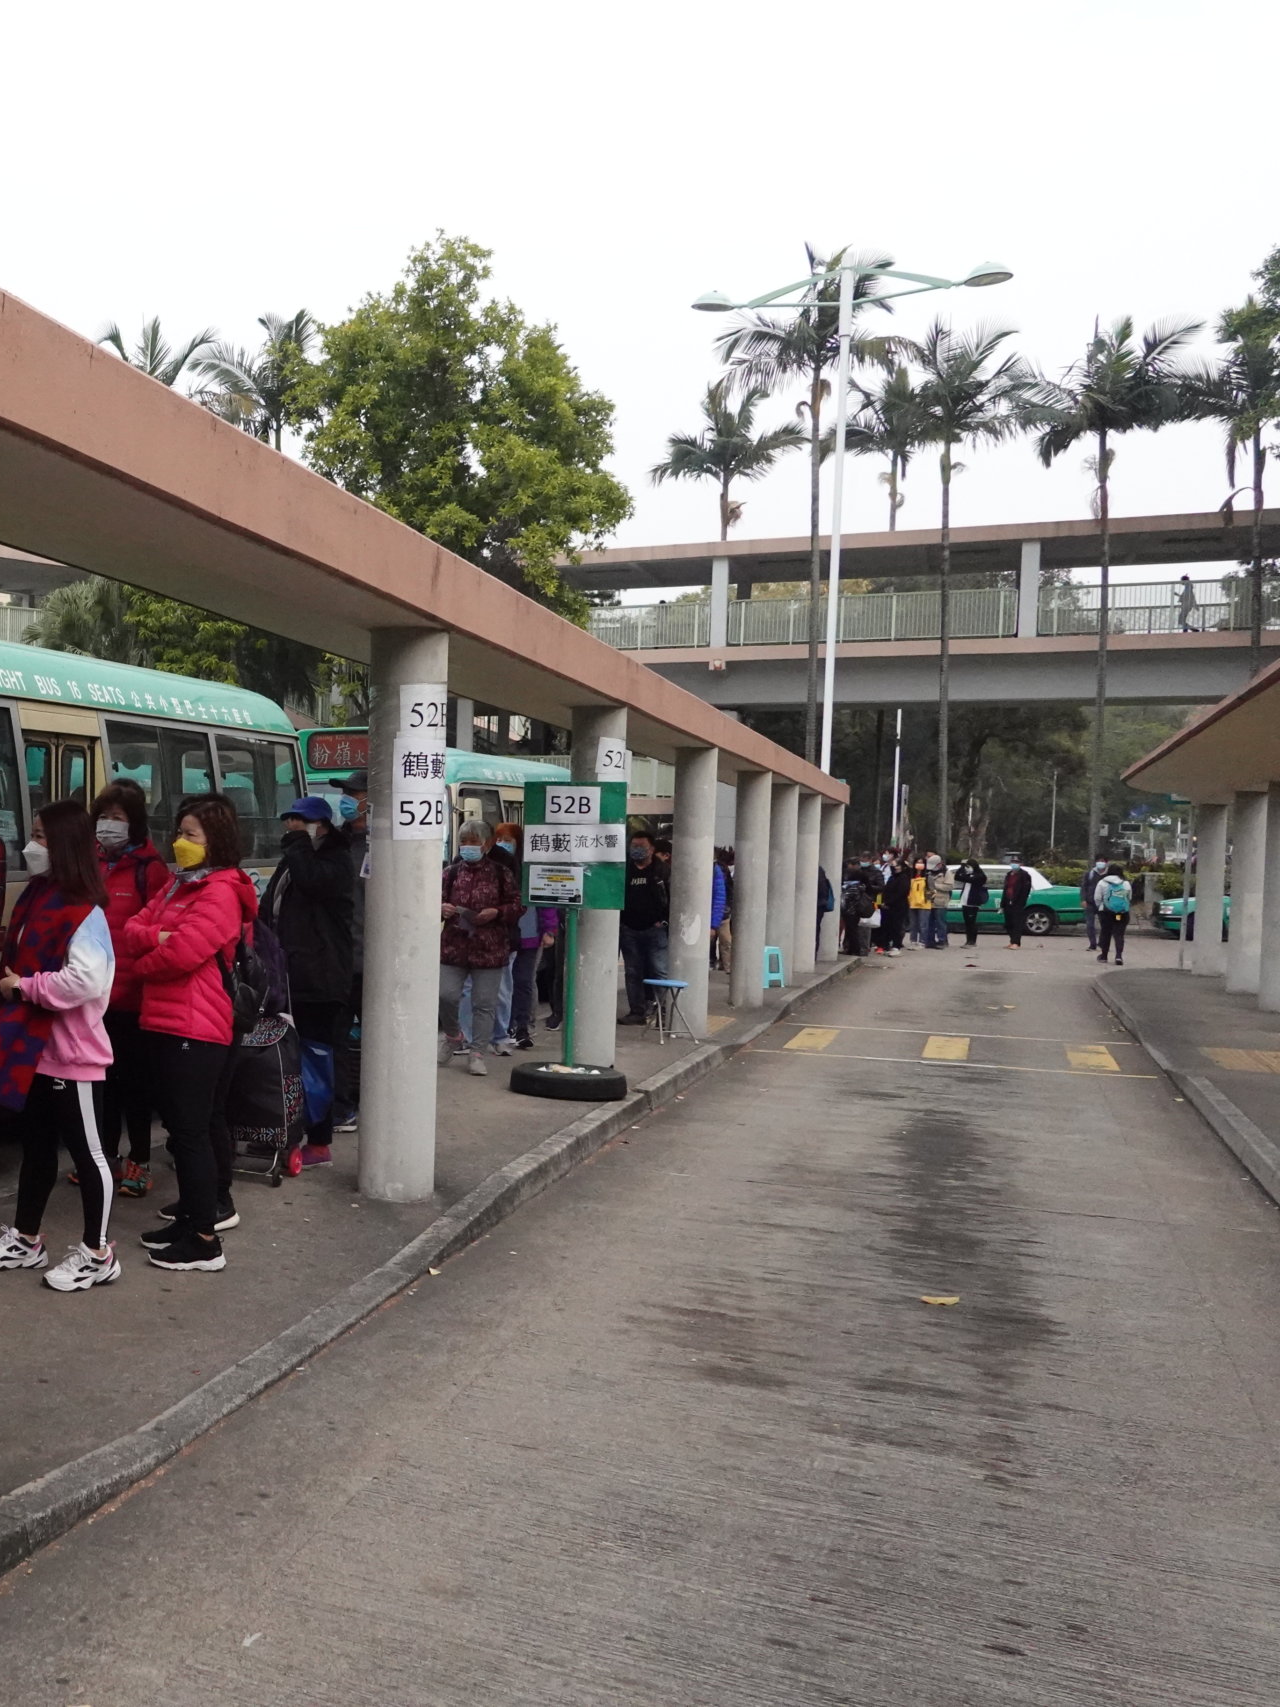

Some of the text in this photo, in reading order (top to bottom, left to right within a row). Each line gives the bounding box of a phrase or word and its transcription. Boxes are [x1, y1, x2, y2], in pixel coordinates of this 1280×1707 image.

[35, 674, 62, 698] BUS
[66, 680, 82, 700] 16
[88, 683, 126, 705] SEATS
[401, 751, 446, 780] 鶴藪
[602, 750, 626, 770] 52
[399, 800, 444, 826] 52B
[550, 795, 591, 814] 52B
[529, 833, 571, 853] 鶴藪
[574, 834, 619, 849] 流水響
